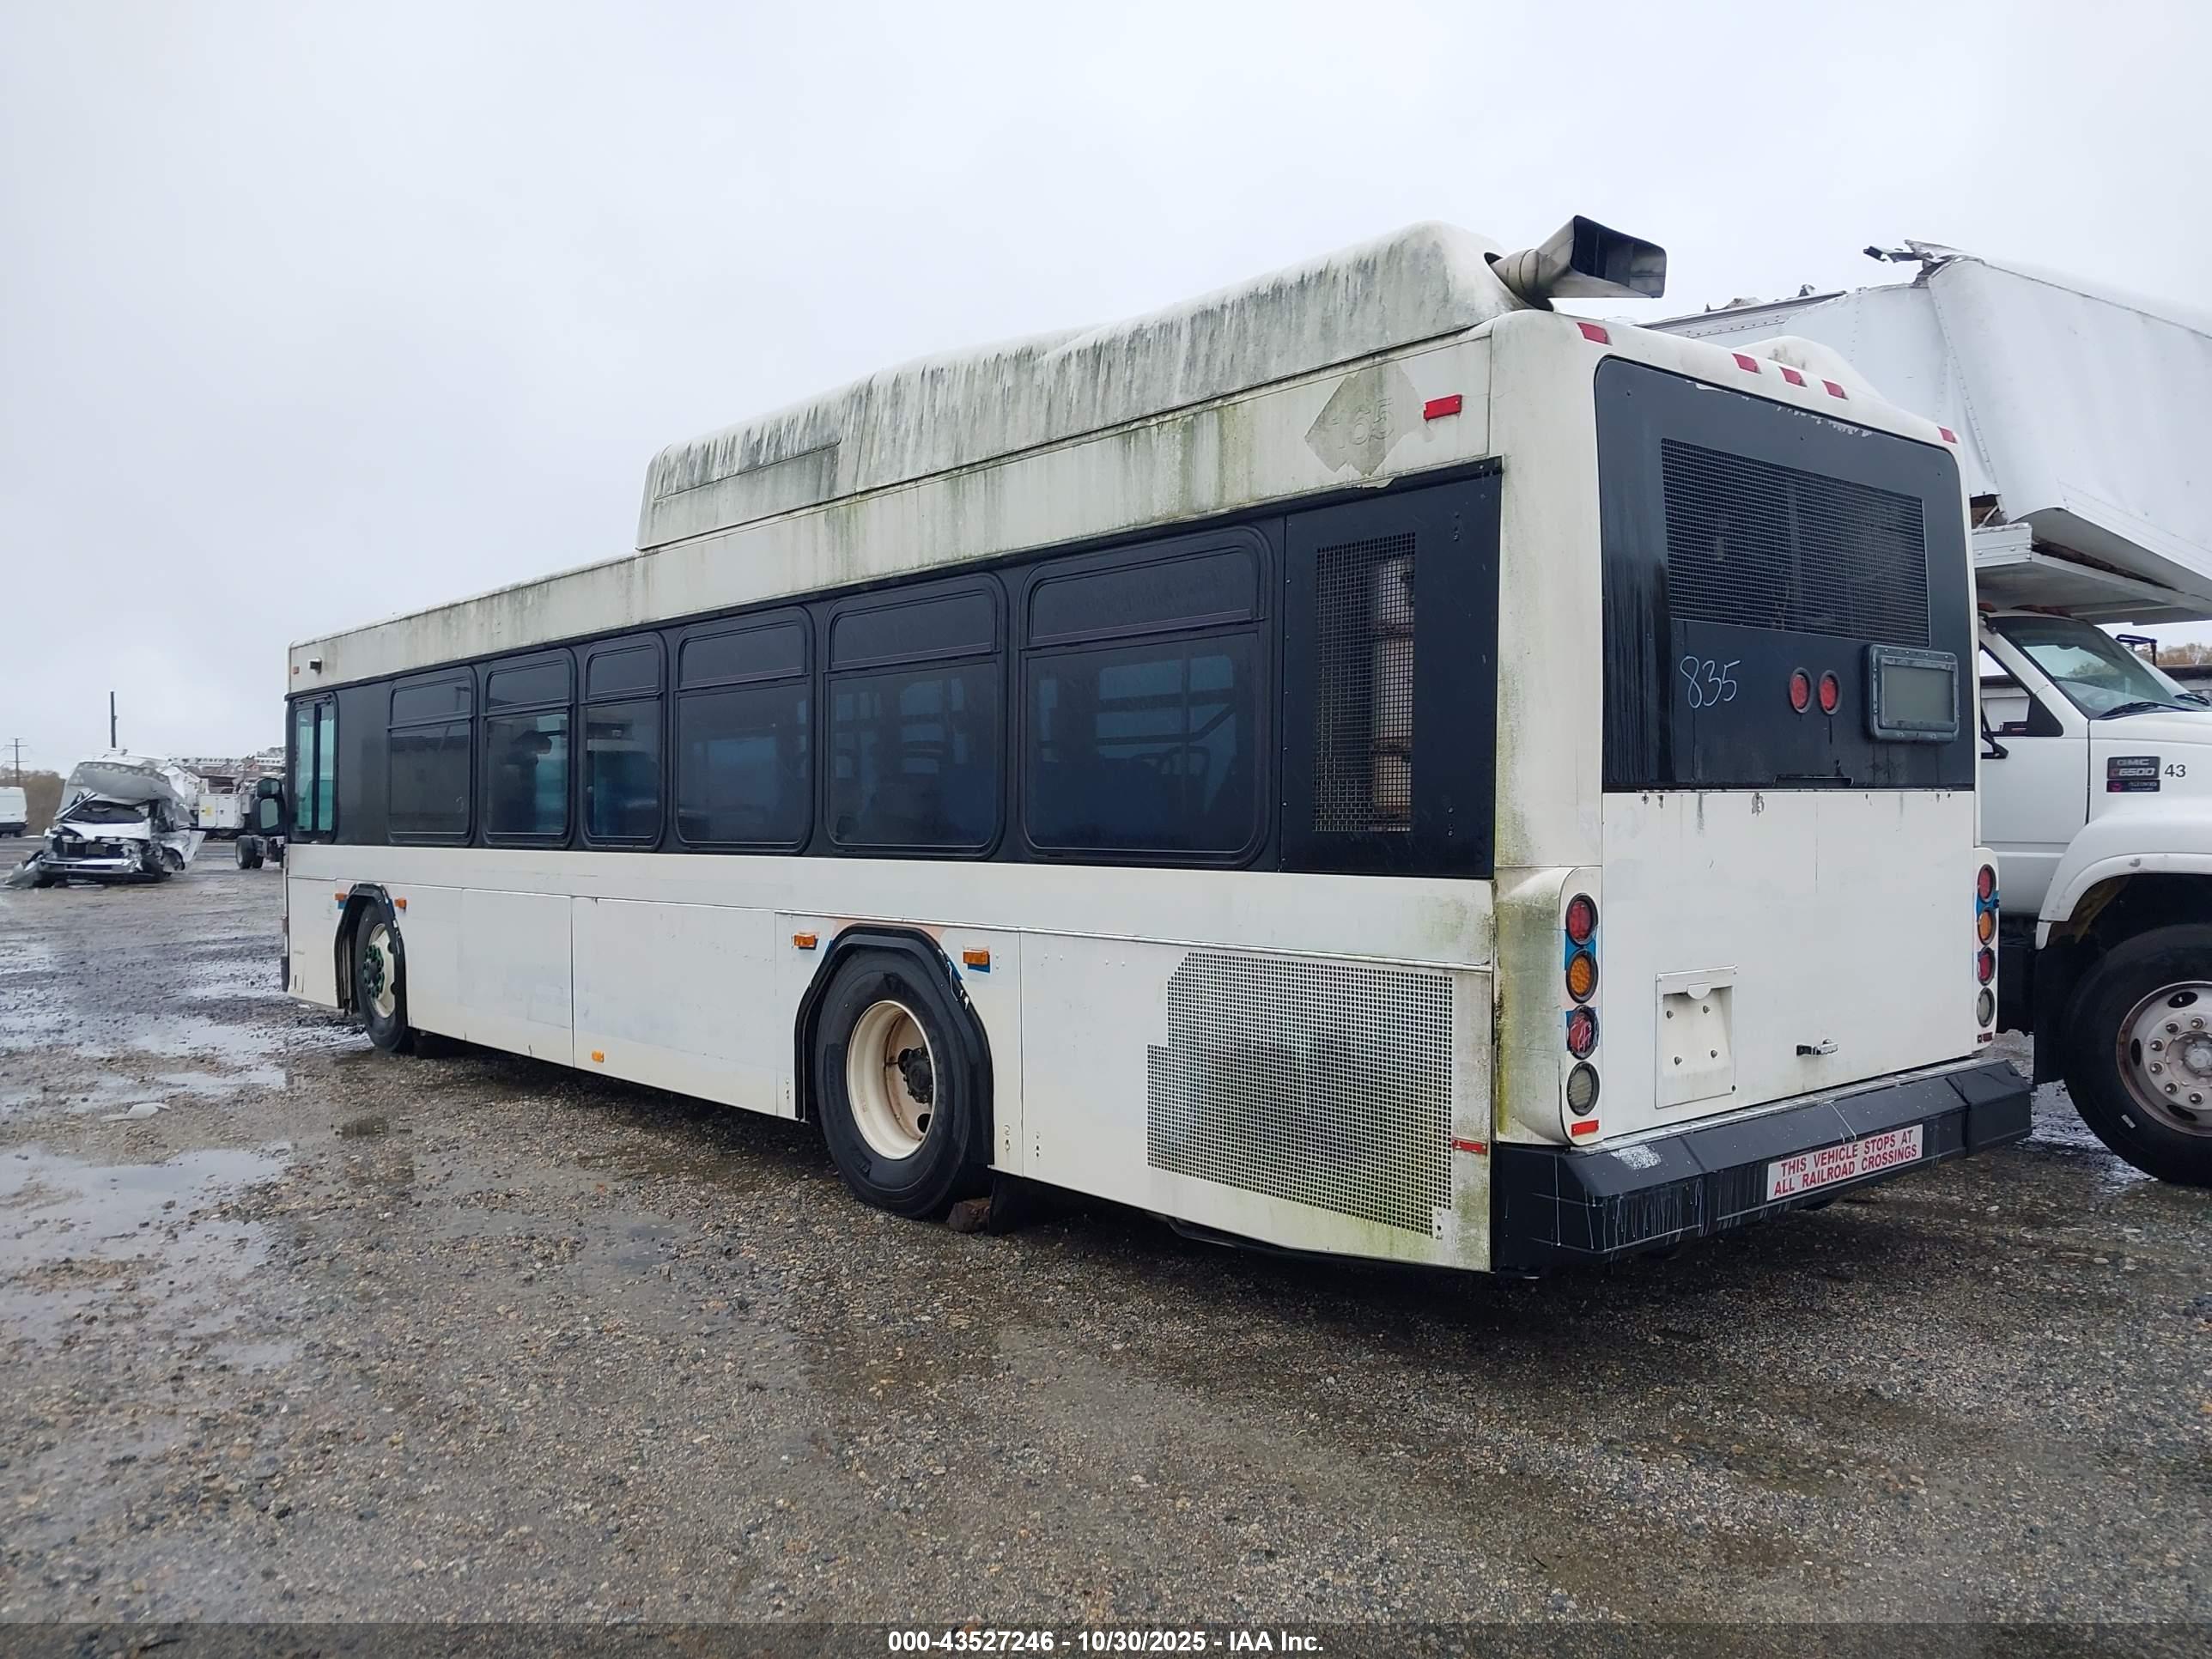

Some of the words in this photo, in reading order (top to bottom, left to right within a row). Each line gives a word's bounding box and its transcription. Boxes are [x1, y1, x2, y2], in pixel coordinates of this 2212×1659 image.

[1680, 655, 1741, 708] 835
[2164, 763, 2186, 778] 43
[1774, 1176, 1796, 1196] ALL
[1802, 1160, 1856, 1188] RAILROAD
[1861, 1144, 1917, 1171] CROSSINGS
[1781, 1157, 1807, 1177] THIS
[1813, 1144, 1858, 1169] VEHICLE
[1863, 1133, 1896, 1155] STOPS
[1900, 1129, 1913, 1146] AT
